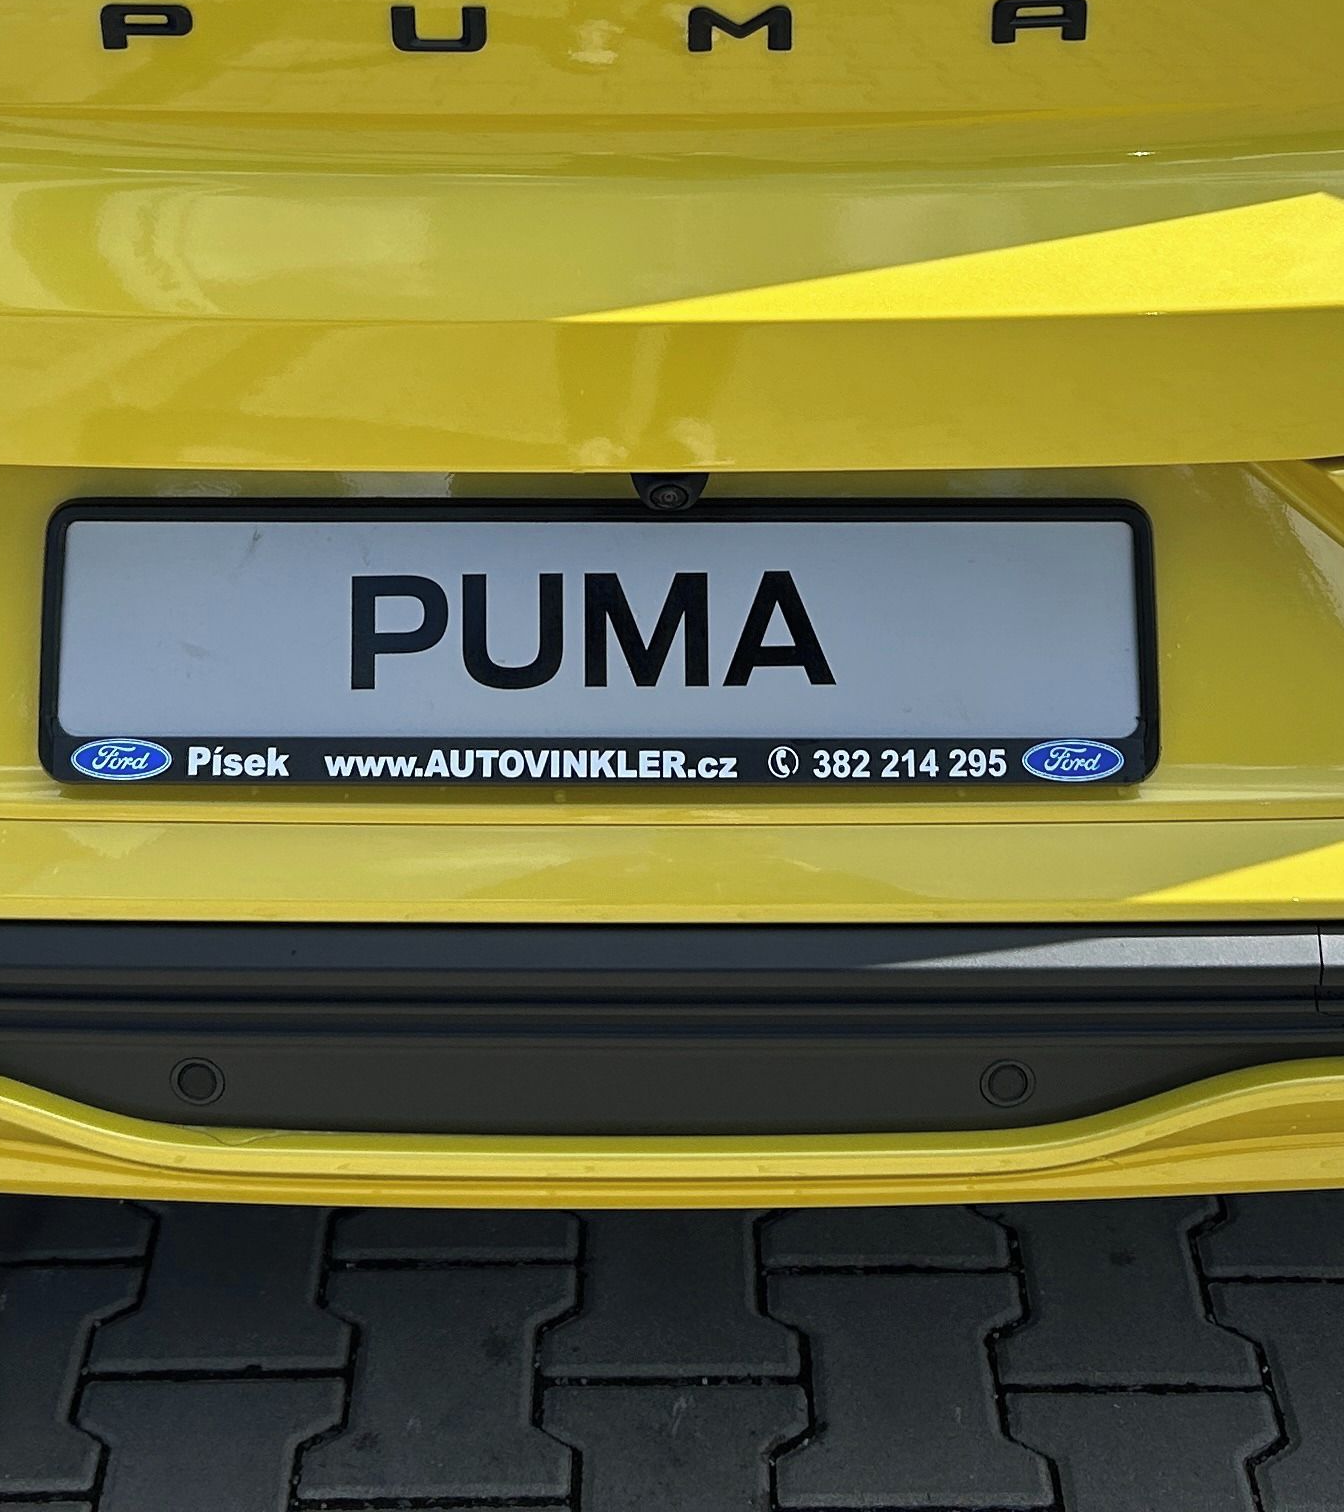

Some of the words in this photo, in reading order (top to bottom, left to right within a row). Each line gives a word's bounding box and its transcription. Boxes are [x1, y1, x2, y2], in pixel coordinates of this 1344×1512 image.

[350, 571, 837, 690] PUMA
[187, 746, 290, 777] Písek
[324, 749, 738, 779] www.AUTOVINKLER.cz
[813, 749, 871, 779] 382
[881, 748, 940, 778] 214
[948, 748, 1007, 778] 295
